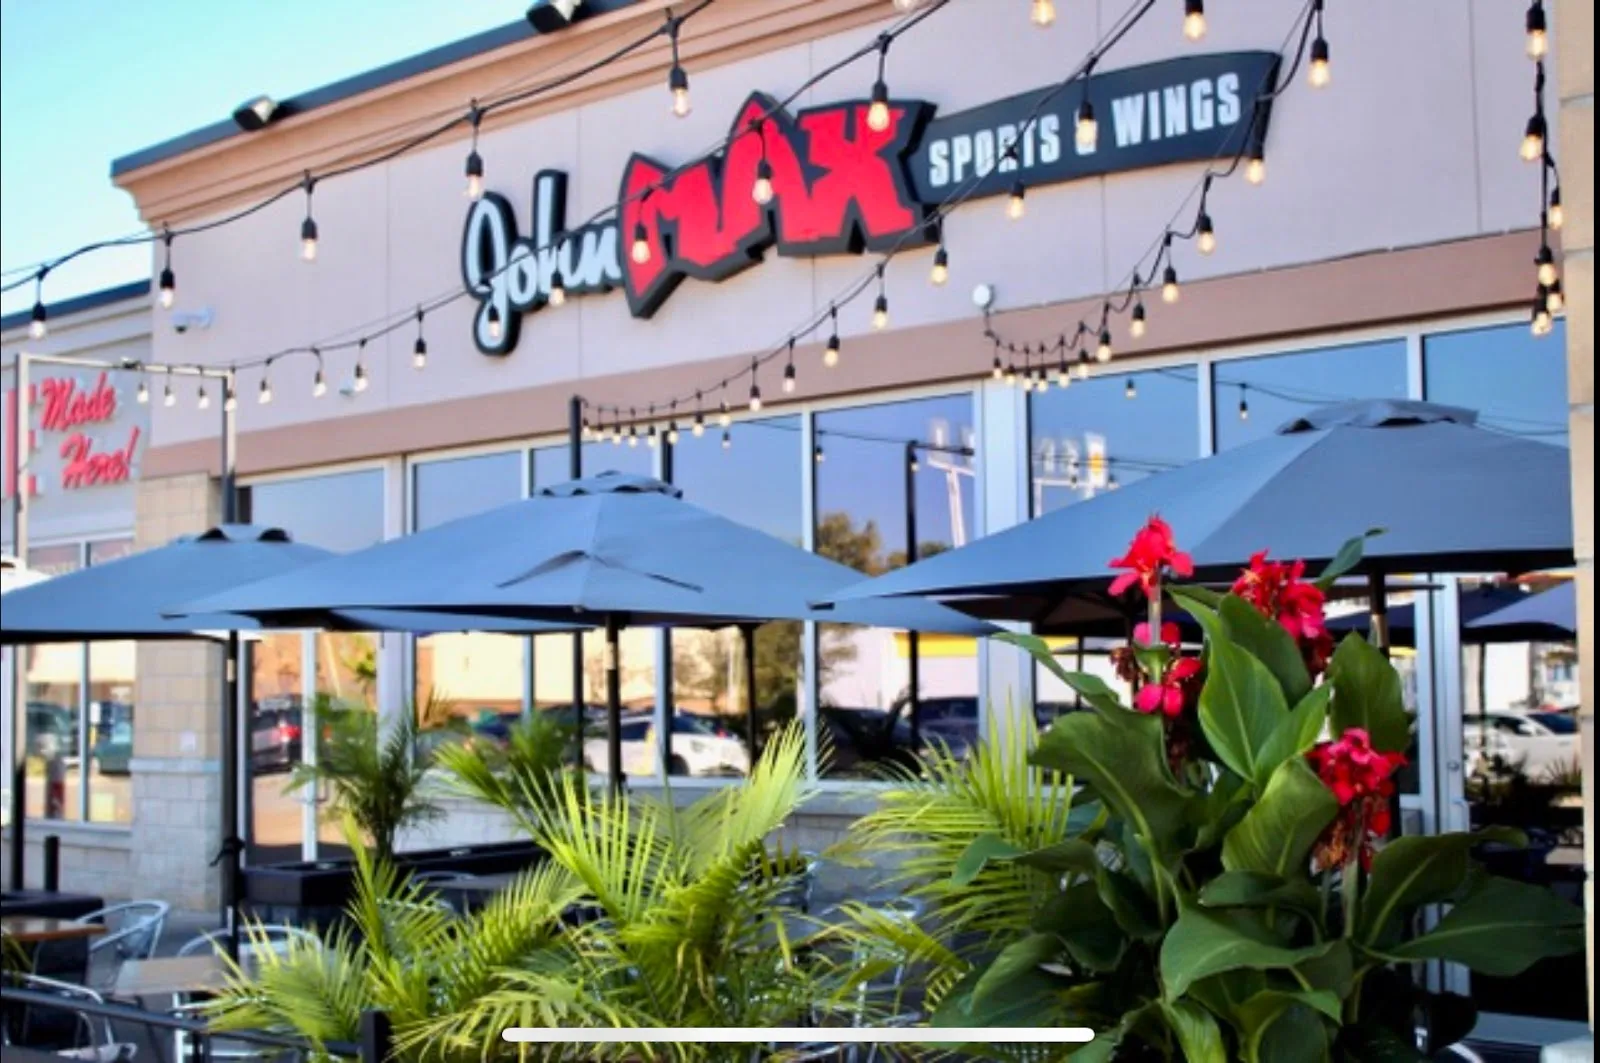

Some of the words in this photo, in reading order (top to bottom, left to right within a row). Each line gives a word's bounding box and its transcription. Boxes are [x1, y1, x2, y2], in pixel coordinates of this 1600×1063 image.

[928, 113, 1060, 188] SPORTS
[1110, 72, 1241, 148] WINGS
[466, 174, 622, 350] John
[621, 101, 916, 298] MAX
[40, 371, 116, 431] Made
[60, 425, 141, 490] Here!
